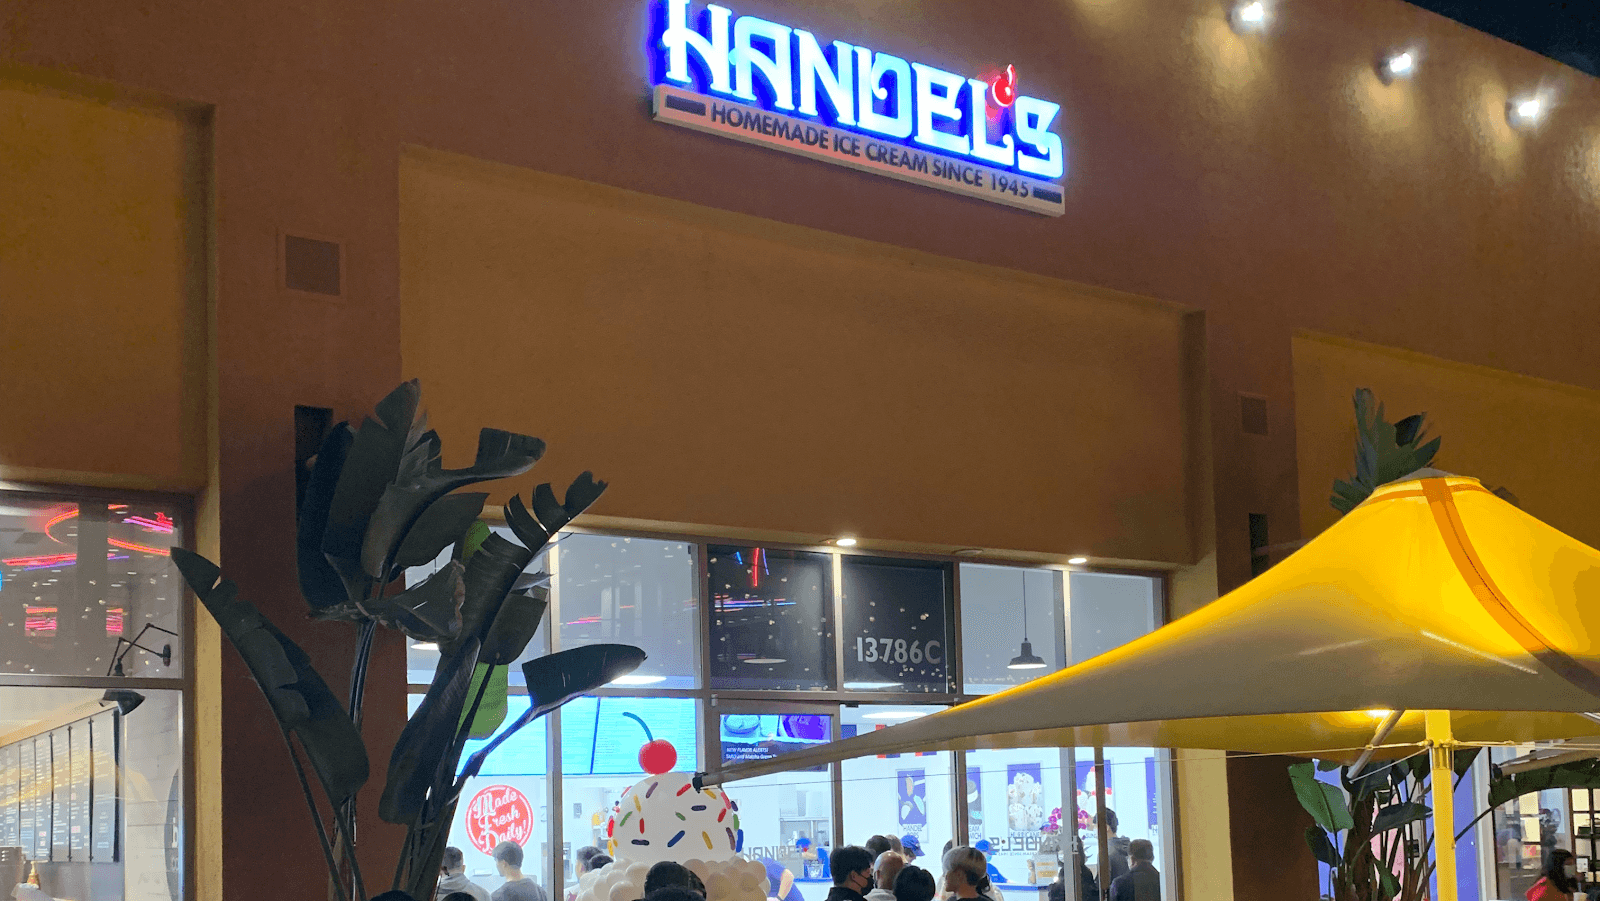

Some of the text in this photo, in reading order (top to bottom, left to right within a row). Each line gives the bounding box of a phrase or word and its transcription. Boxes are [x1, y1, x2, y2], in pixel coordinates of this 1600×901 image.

[661, 0, 1064, 179] HANDEL'S
[711, 102, 1029, 198] HOMEMADE ICE CREAM SINCE 1945
[857, 636, 941, 664] 13786C
[473, 787, 518, 819] Made
[478, 804, 521, 836] Fresh
